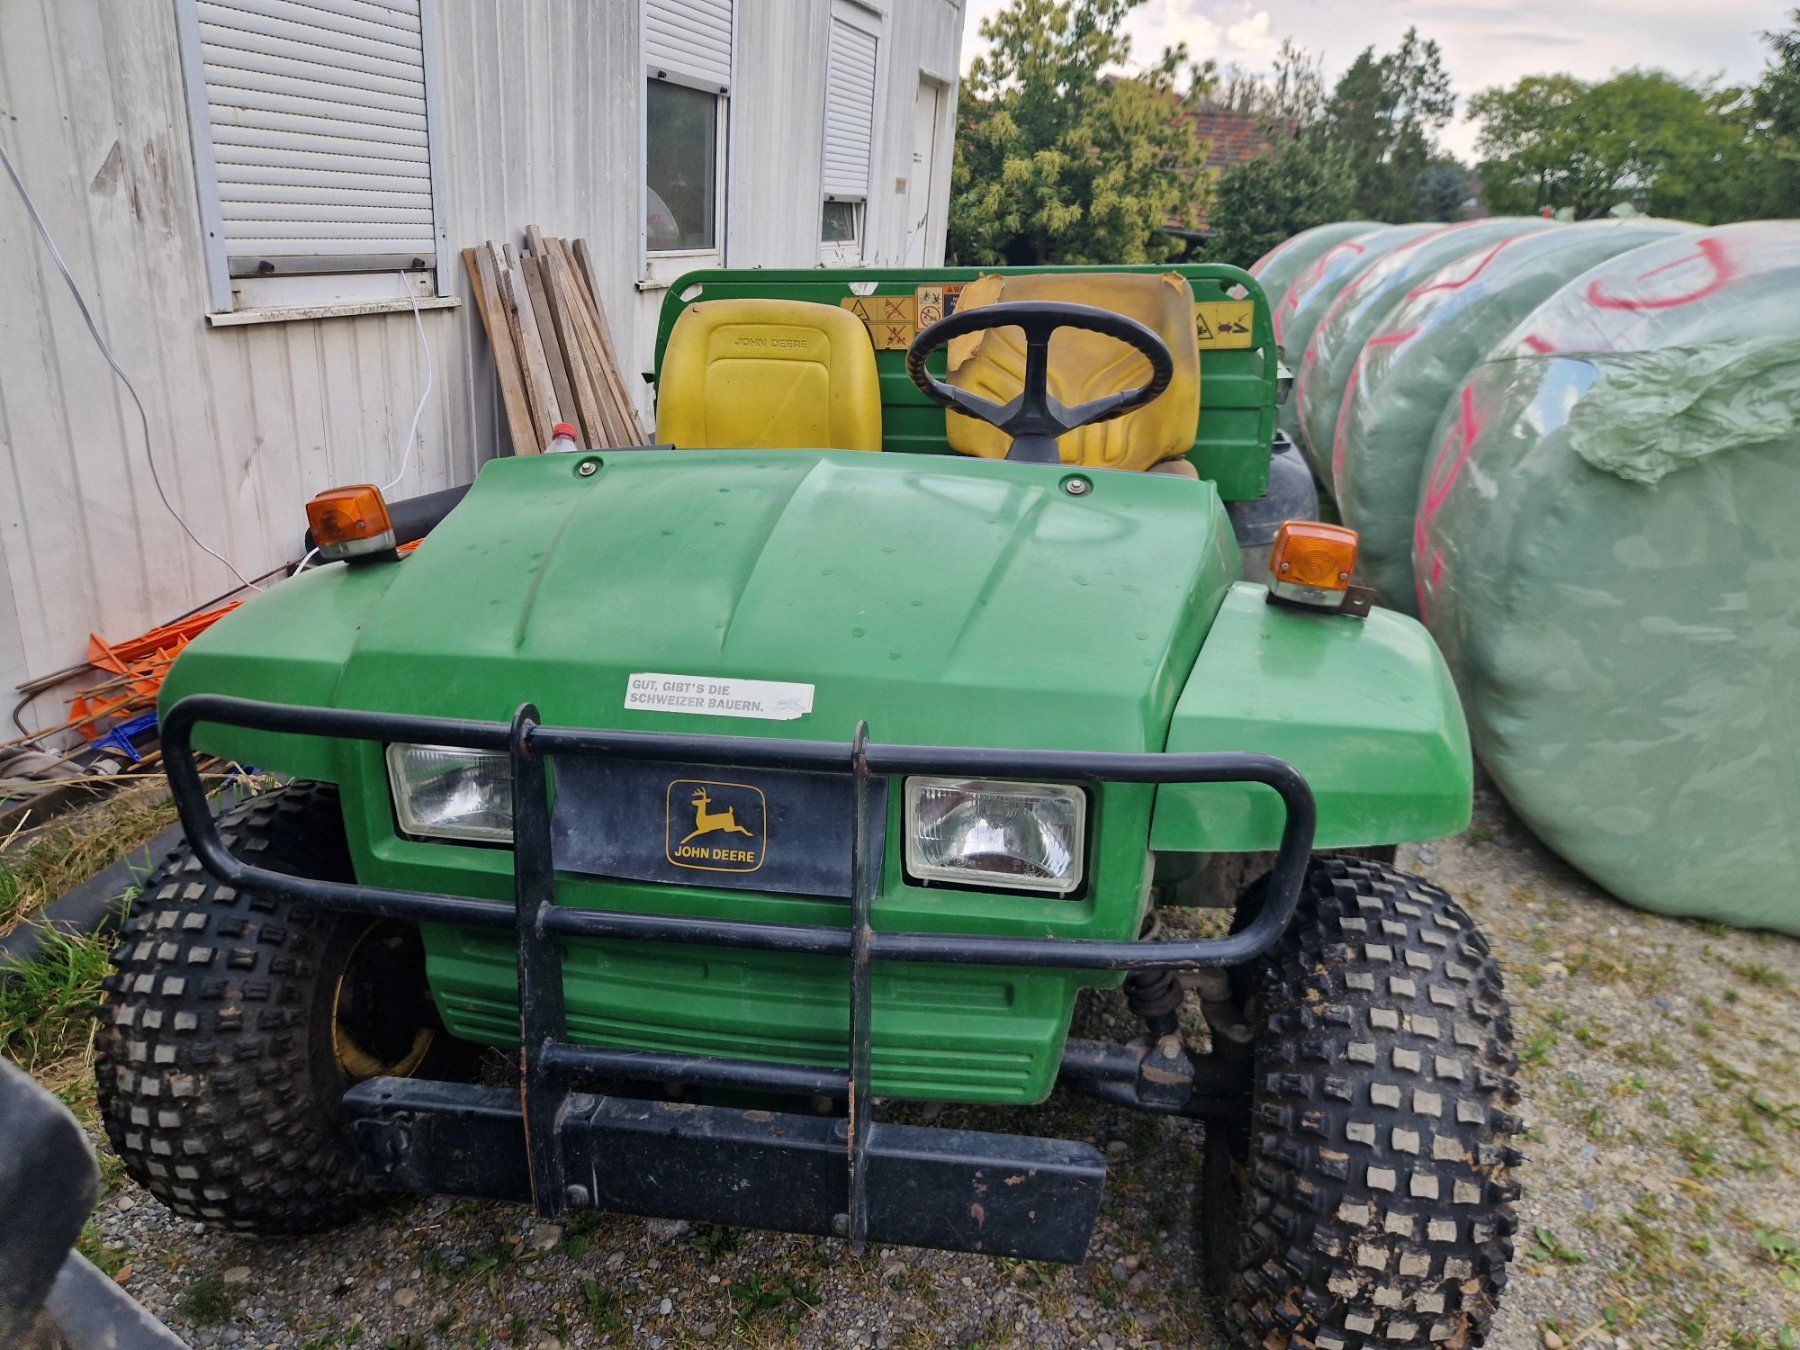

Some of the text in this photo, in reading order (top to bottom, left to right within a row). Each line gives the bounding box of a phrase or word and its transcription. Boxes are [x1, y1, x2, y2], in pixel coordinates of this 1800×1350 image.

[734, 337, 808, 349] JOHN DEERE
[633, 679, 731, 696] GUT, GIBT'S DIE
[630, 693, 764, 712] SCHWEIZER BAUERN.
[675, 846, 755, 862] JOHN DEERE
